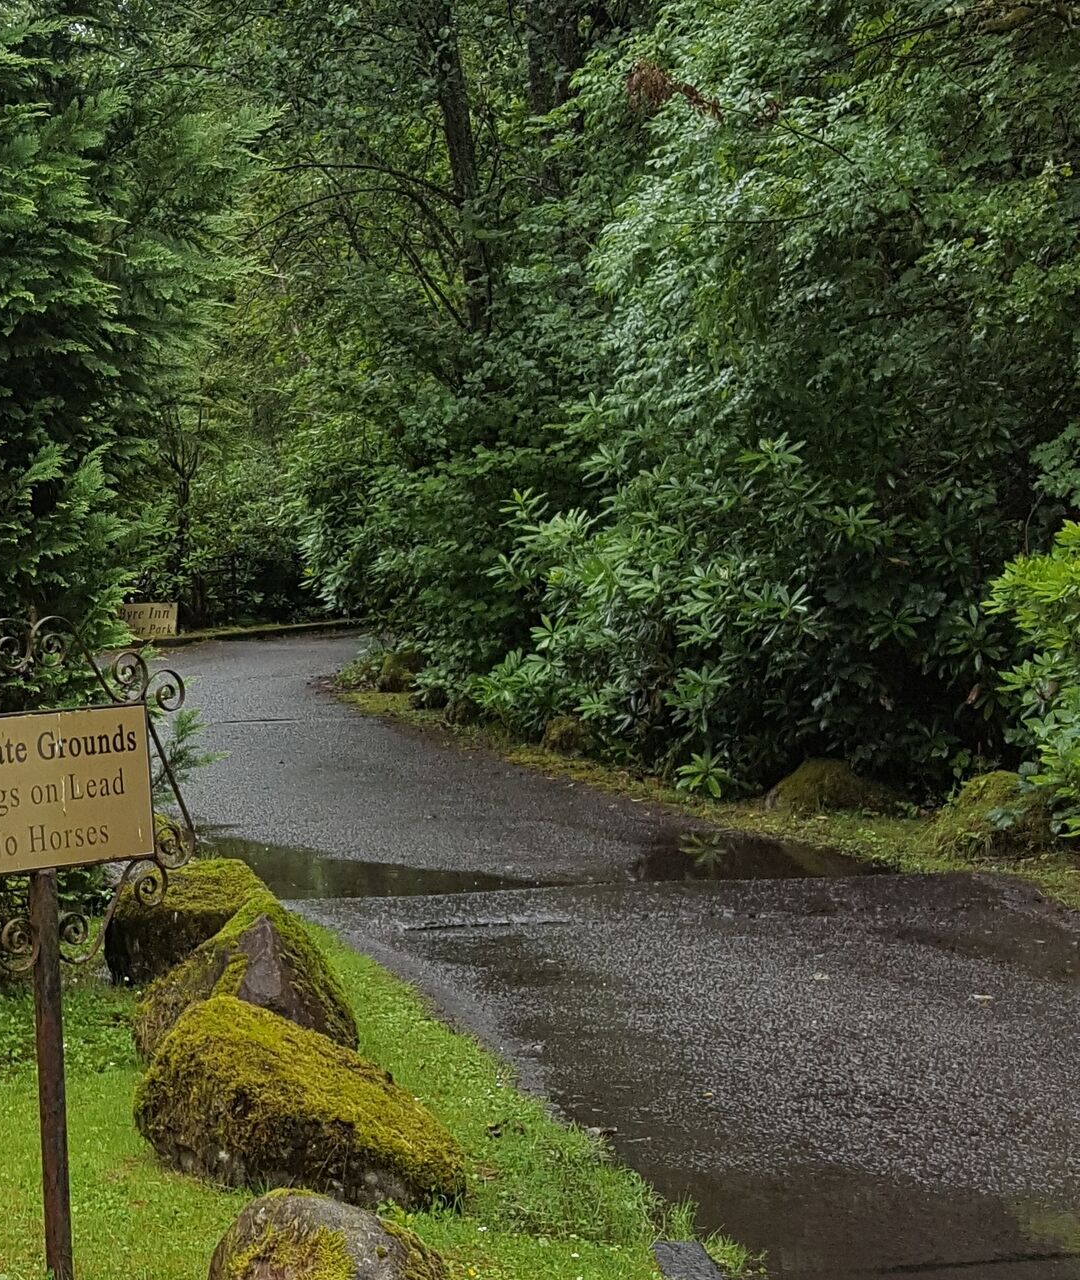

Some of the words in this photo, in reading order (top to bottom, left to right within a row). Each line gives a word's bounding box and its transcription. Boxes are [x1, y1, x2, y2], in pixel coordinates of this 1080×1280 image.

[148, 607, 170, 619] Inn
[148, 624, 173, 635] Park
[36, 725, 137, 761] Grounds
[30, 783, 58, 805] on
[69, 768, 125, 801] Lead
[28, 823, 109, 853] Horses
